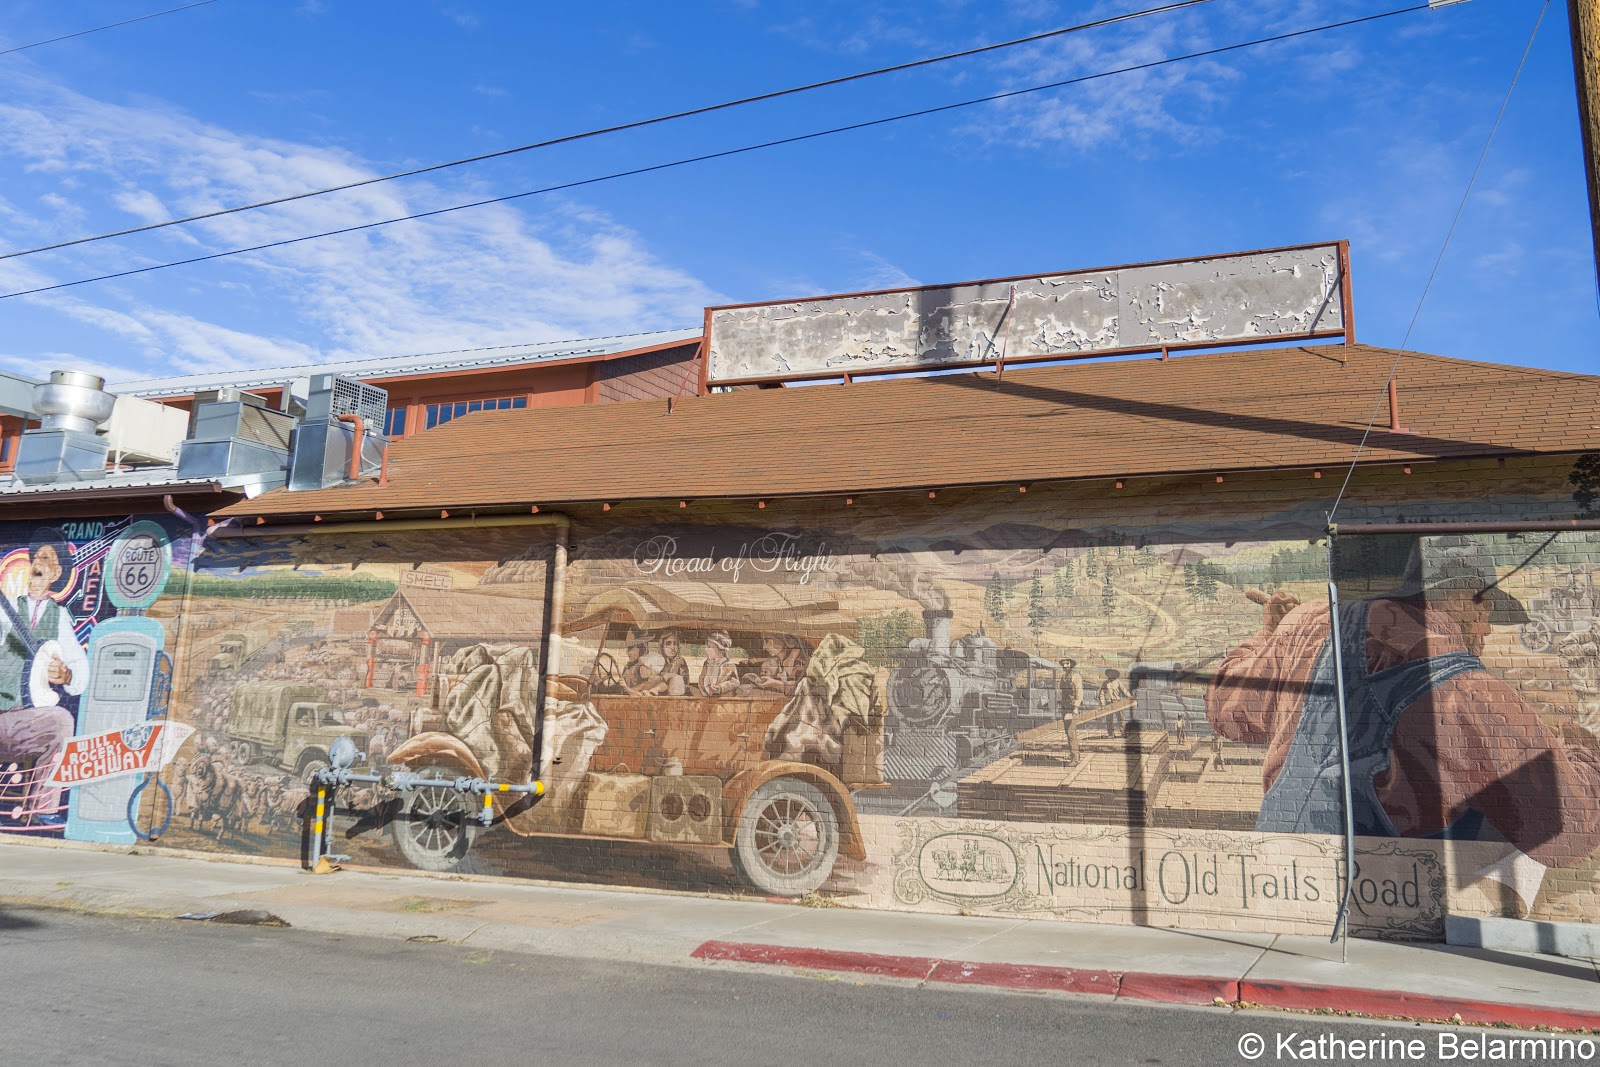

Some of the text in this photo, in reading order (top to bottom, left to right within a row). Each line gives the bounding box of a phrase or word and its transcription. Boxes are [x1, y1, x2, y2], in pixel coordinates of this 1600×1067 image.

[61, 522, 104, 540] GRAND
[125, 550, 155, 562] ROUTE
[633, 532, 838, 585] Road of Flight
[83, 560, 101, 611] AFE
[125, 566, 149, 586] 66
[76, 735, 111, 752] WILL
[60, 750, 147, 782] HIGHWAY
[1034, 844, 1420, 917] National Old Trails Road
